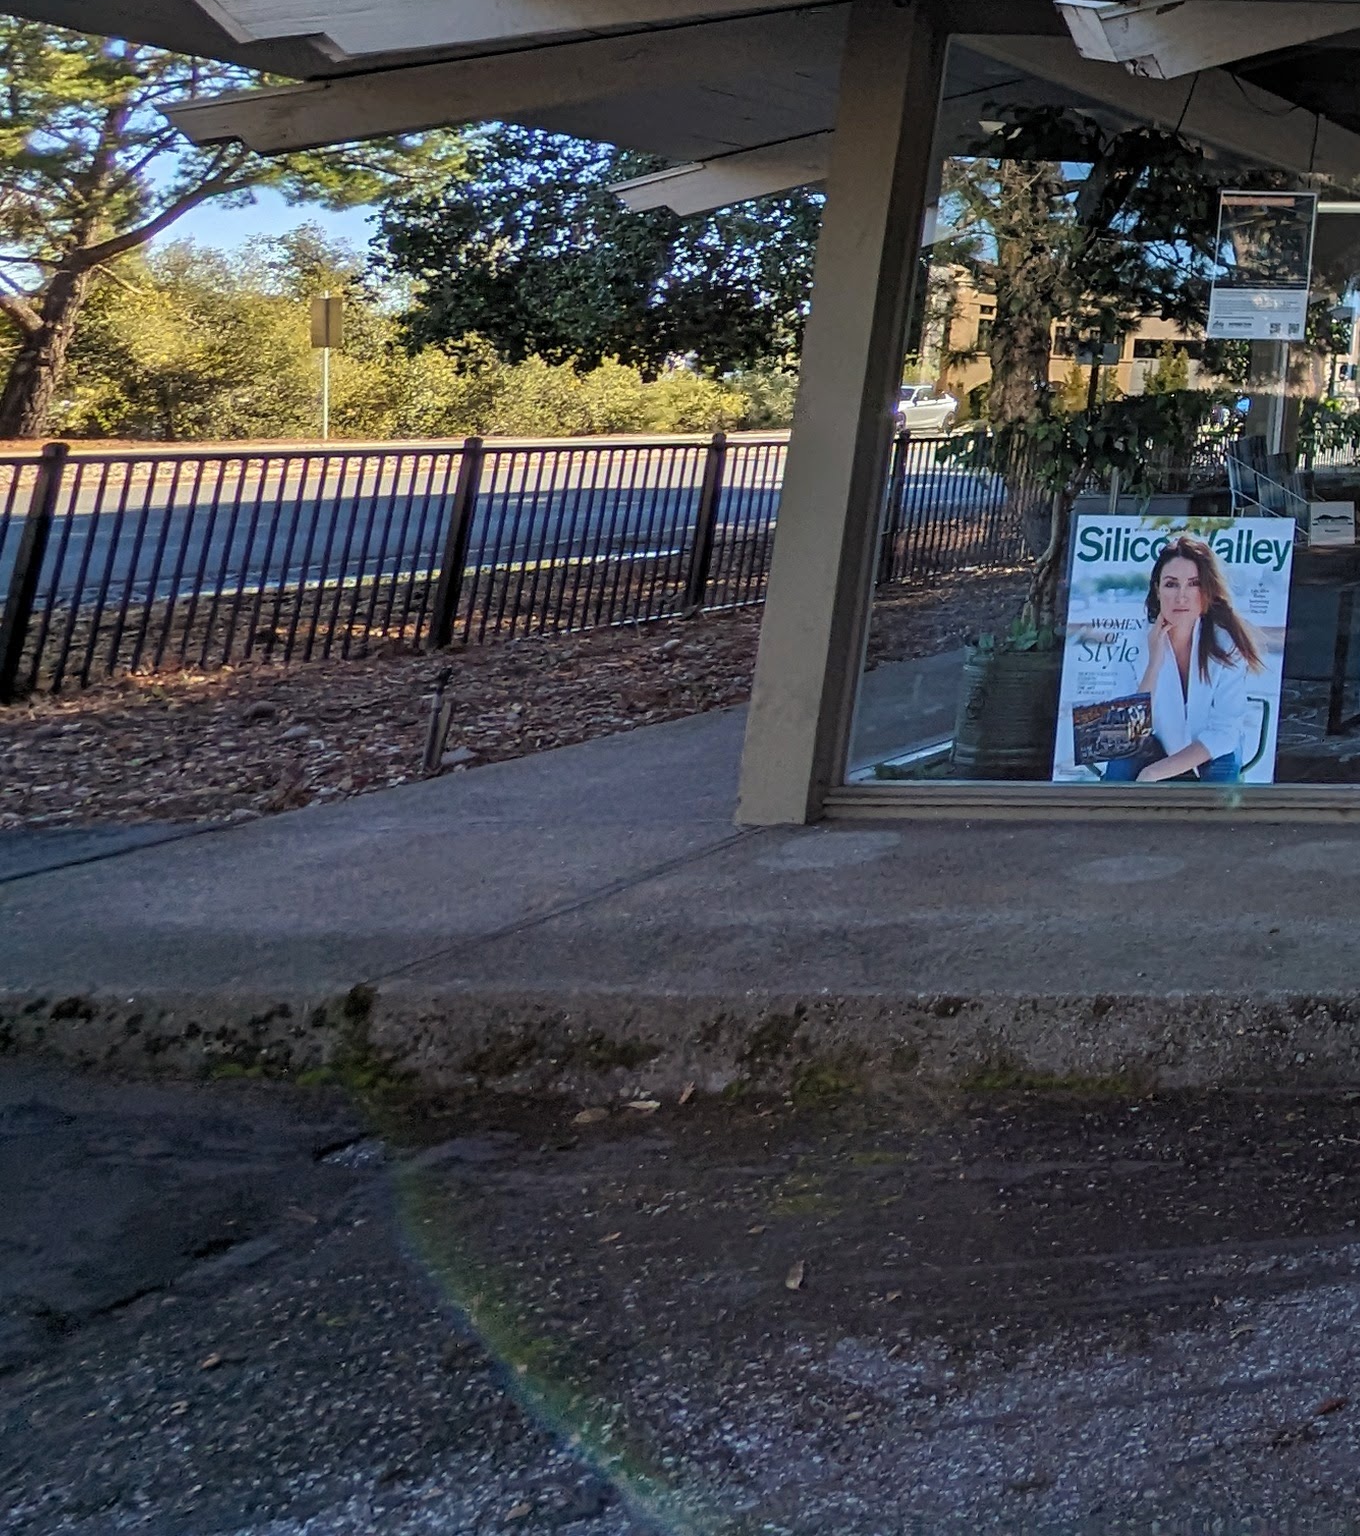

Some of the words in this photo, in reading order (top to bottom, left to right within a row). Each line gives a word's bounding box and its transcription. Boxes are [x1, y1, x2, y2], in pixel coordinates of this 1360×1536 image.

[1091, 618, 1146, 630] WOMEN
[1105, 633, 1124, 644] OF
[1077, 639, 1140, 672] Style
